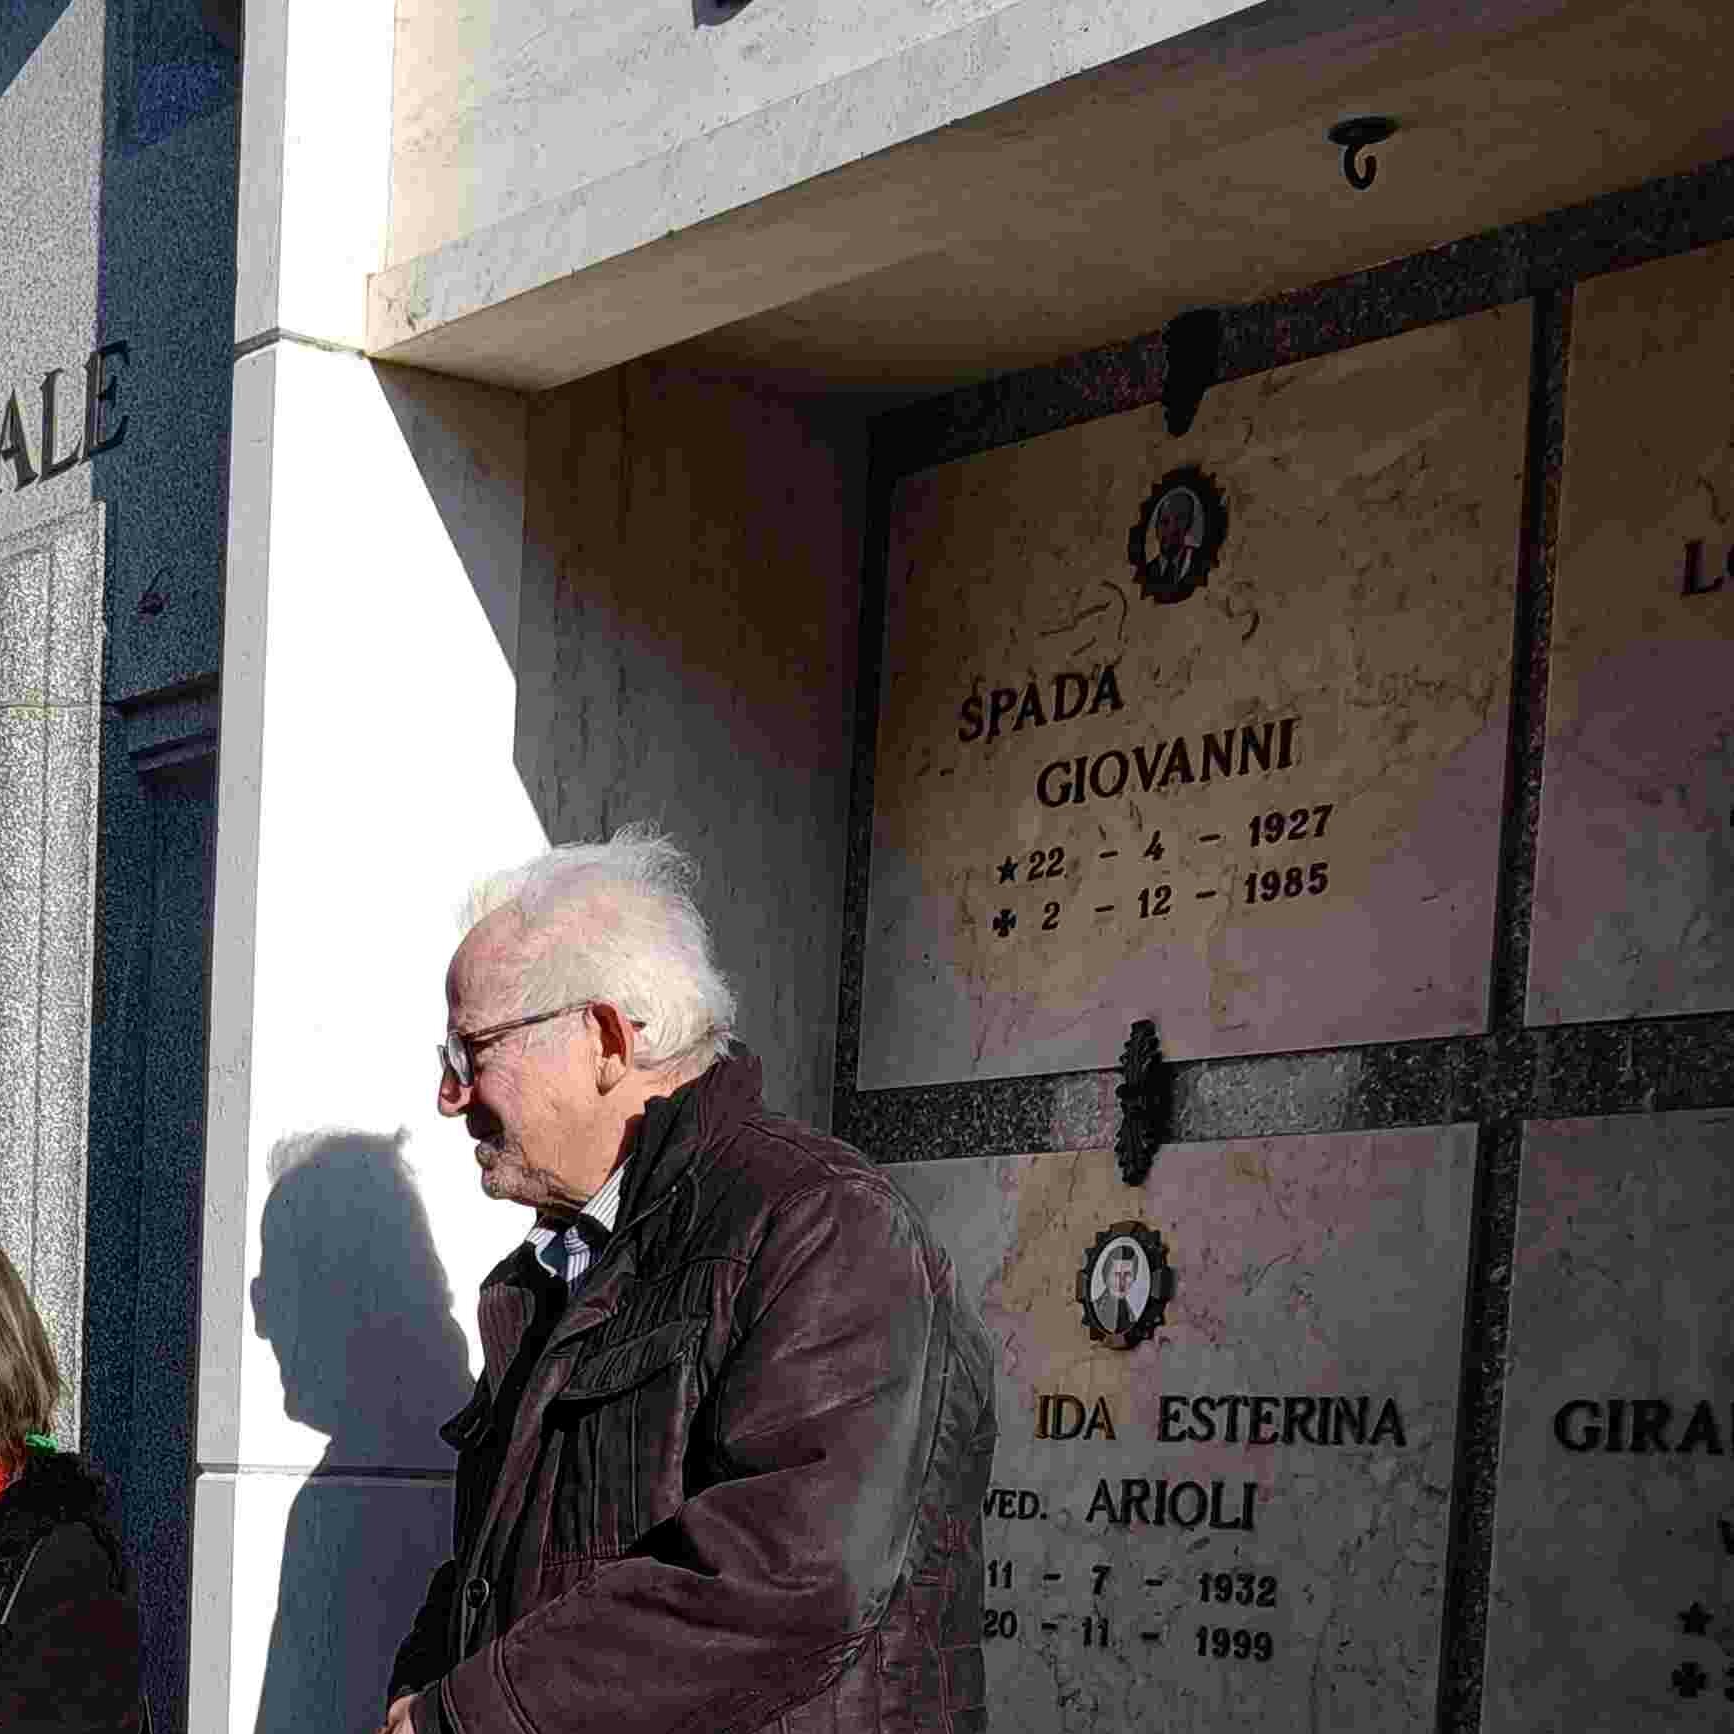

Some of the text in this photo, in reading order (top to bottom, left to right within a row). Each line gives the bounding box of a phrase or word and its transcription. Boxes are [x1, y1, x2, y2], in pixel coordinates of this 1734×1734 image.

[1681, 536, 1734, 600] L
[957, 663, 1125, 743] SPADA
[1035, 717, 1301, 808] GIOVANNI
[1026, 846, 1066, 882] 22
[1142, 829, 1165, 861] 4
[1248, 803, 1334, 848] 1927
[1041, 901, 1061, 931] 2
[1137, 884, 1173, 919] 12
[1243, 862, 1329, 904] 1985
[1035, 1393, 1407, 1447] IDA ESTERINA
[1553, 1398, 1734, 1456] GIRA
[983, 1479, 1259, 1530] VED. ARIOLI
[1091, 1564, 1110, 1596] 7
[1198, 1572, 1277, 1609] 1932
[983, 1609, 1018, 1639] 20
[1082, 1616, 1110, 1649] 11
[1196, 1625, 1275, 1662] 1999
